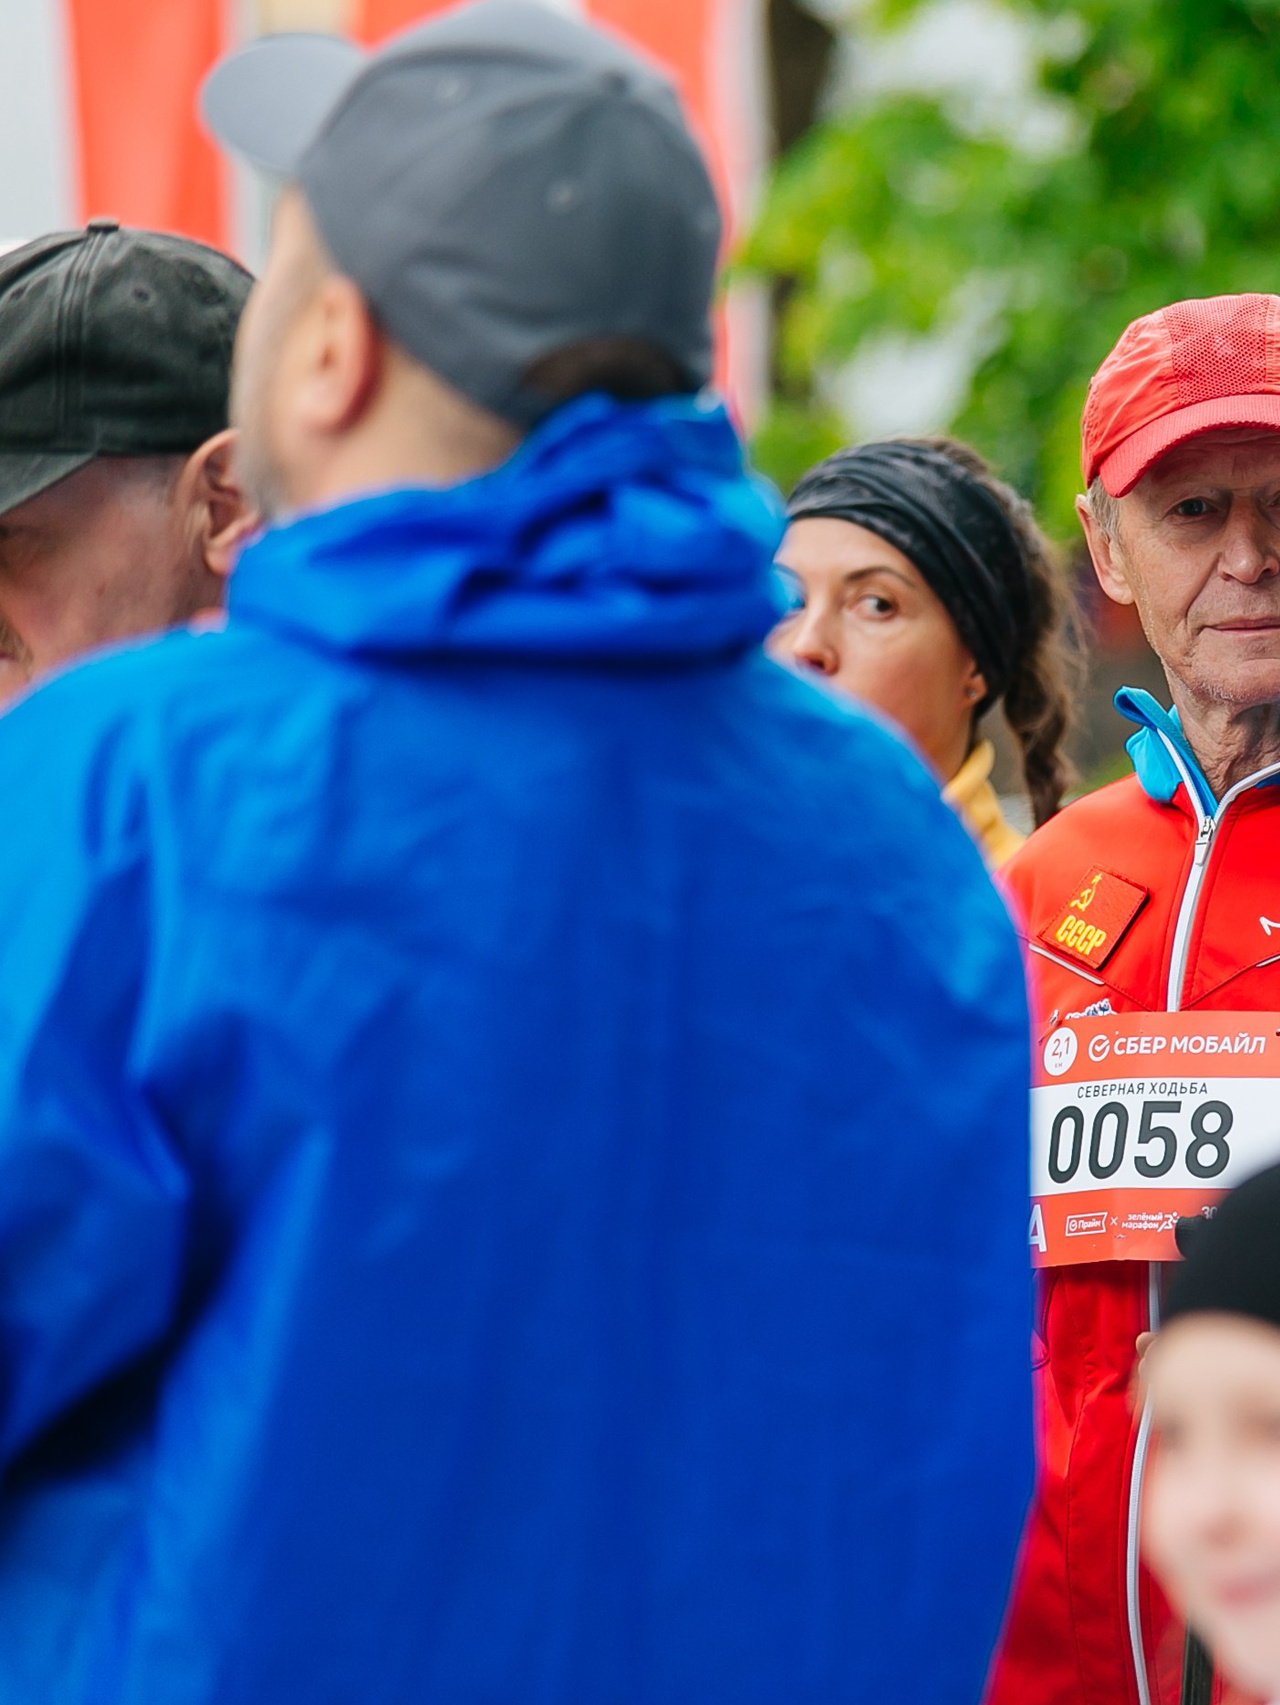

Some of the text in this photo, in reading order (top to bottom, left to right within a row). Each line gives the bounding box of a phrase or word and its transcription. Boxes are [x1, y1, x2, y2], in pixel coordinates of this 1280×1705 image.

[1055, 915, 1107, 956] СССР
[1051, 1036, 1071, 1059] 2,1
[1113, 1032, 1266, 1056] СБЕР МОБАЙЛ
[1077, 1081, 1208, 1099] СЕВЕРНАЯ ХОДЬБА
[1048, 1100, 1234, 1184] 0058
[1077, 1218, 1102, 1230] Прайм
[1121, 1221, 1159, 1231] марафон
[1127, 1212, 1164, 1222] зелёный
